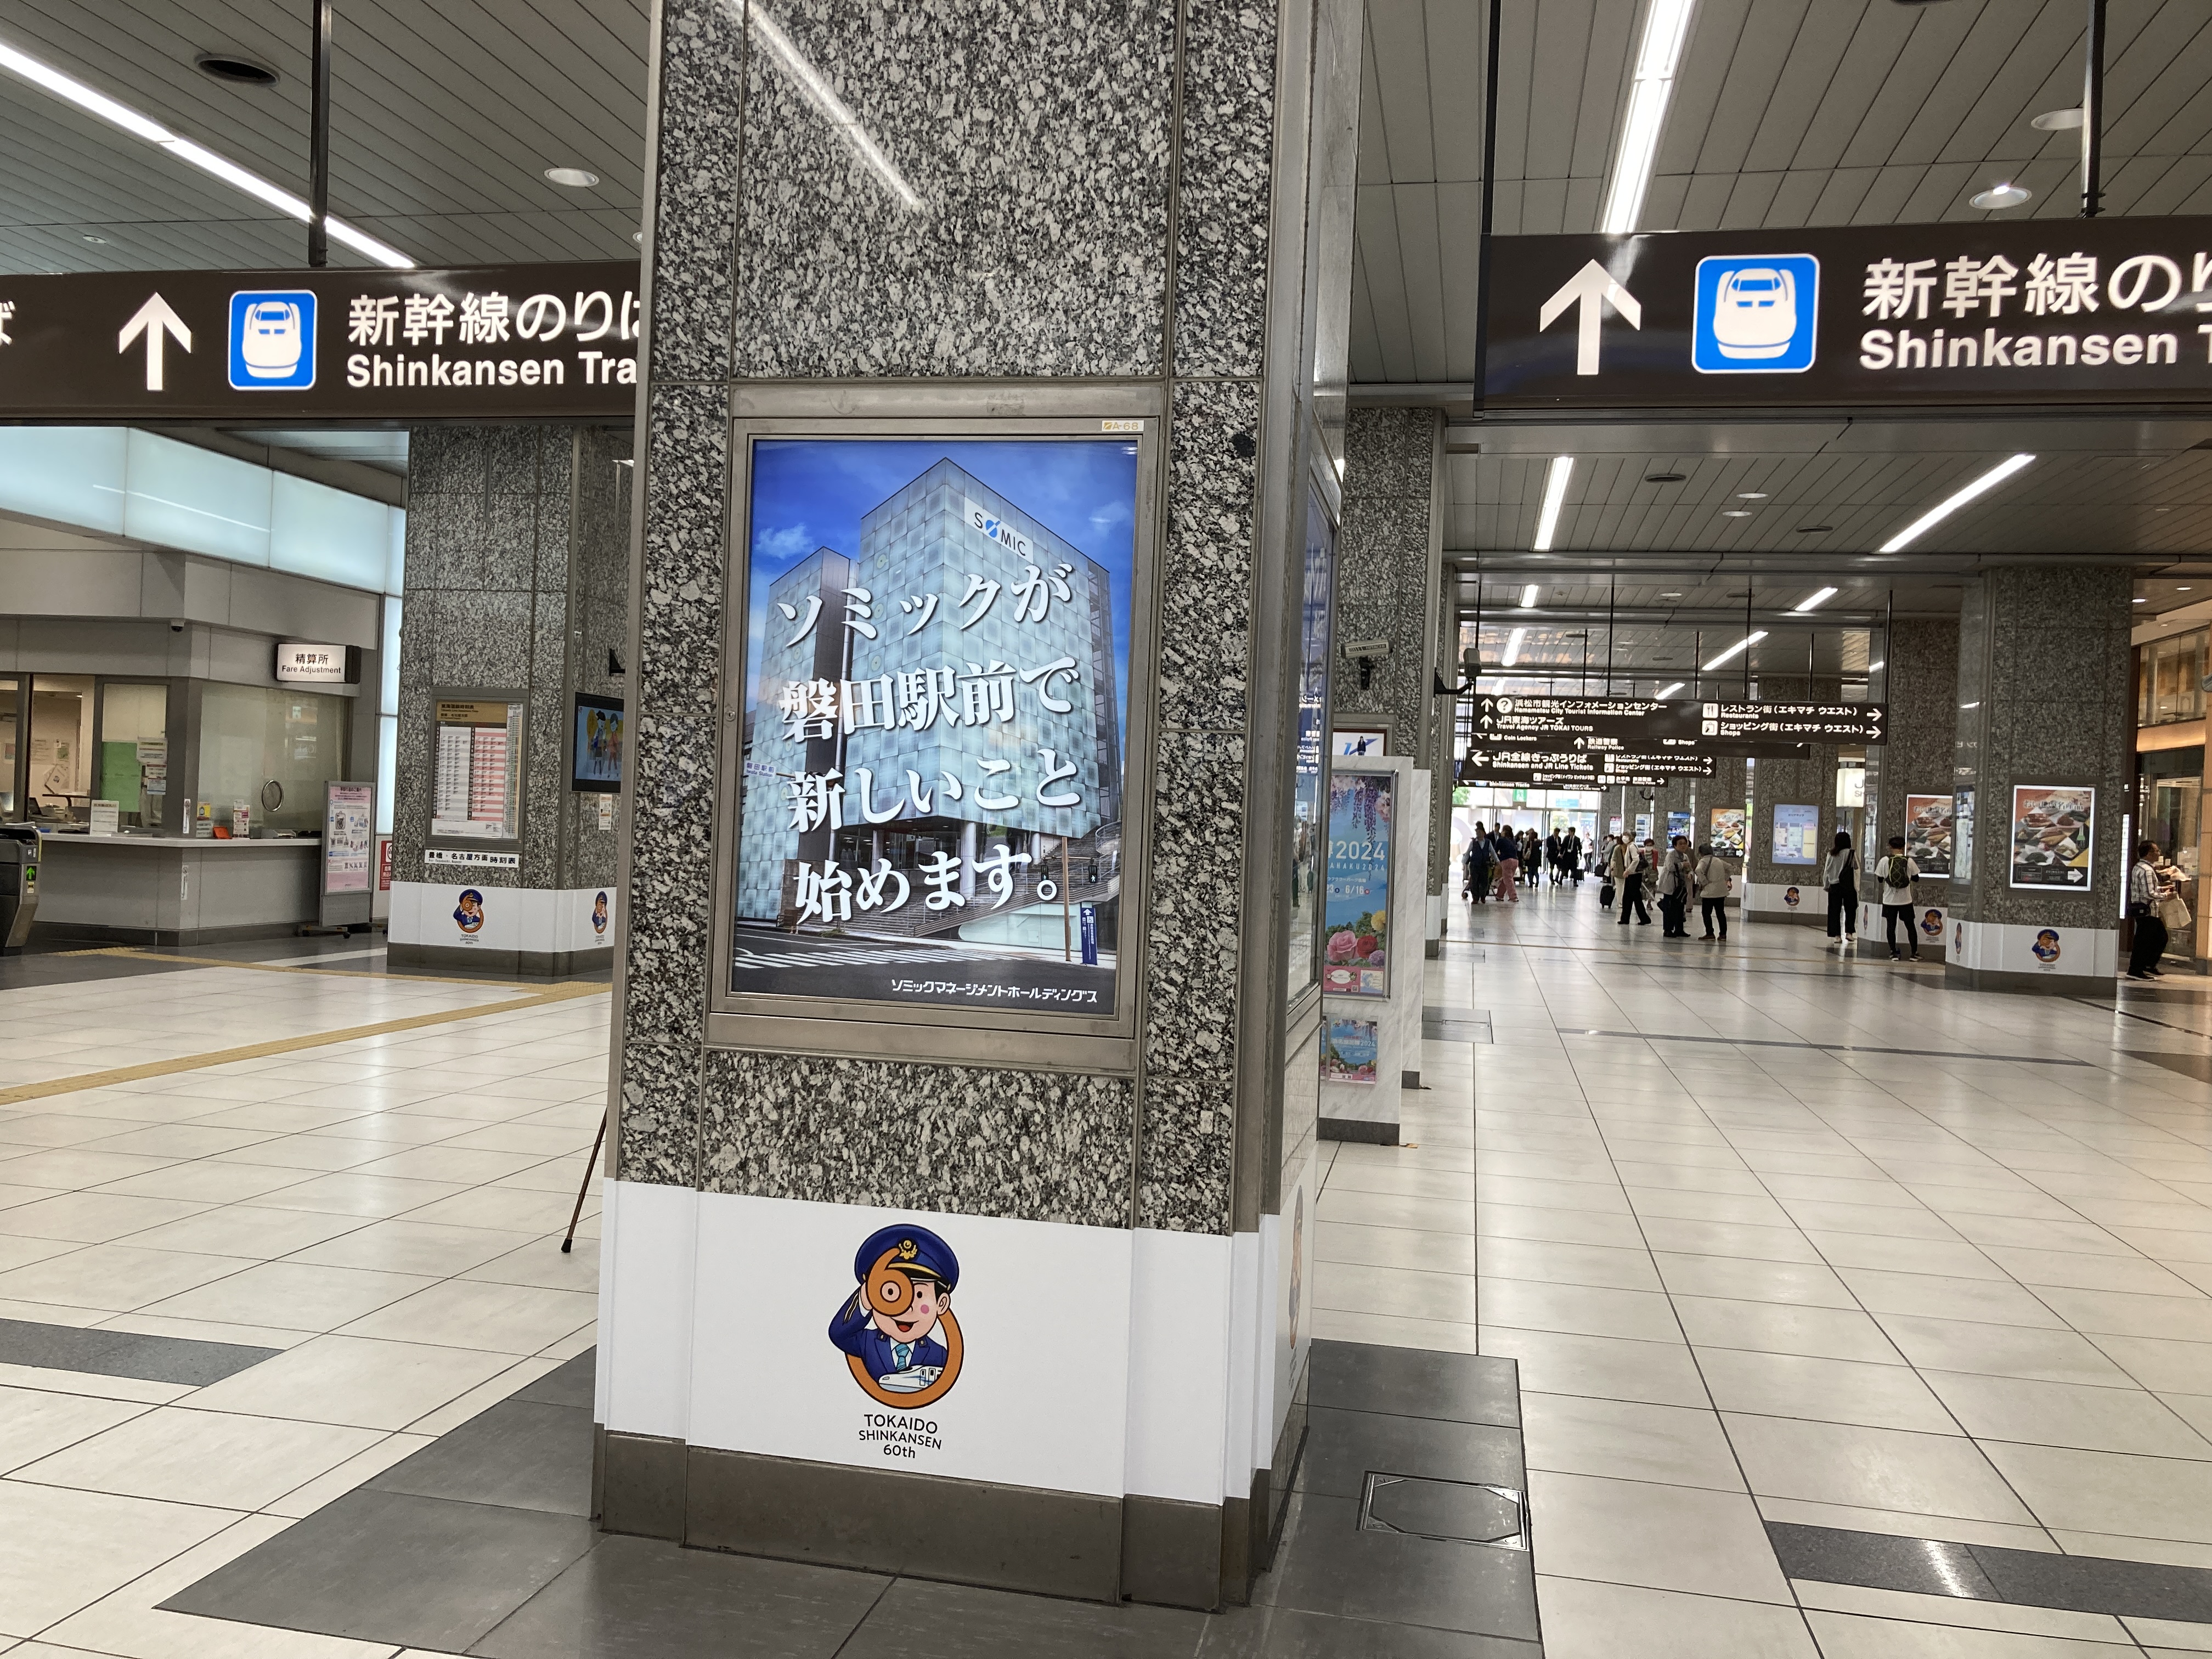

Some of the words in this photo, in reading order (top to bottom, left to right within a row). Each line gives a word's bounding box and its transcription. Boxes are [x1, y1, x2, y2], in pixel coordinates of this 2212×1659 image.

[1860, 328, 2177, 370] Shinkansen
[347, 353, 564, 387] Shinkansen
[1113, 422, 1138, 430] A-68
[777, 563, 1075, 647] ソミックが
[296, 653, 328, 664] 精算所
[300, 666, 341, 674] Adjustment
[780, 657, 1079, 742] 磐田駅前で
[1515, 699, 1667, 710] 浜松市観光インフォメーションセンター
[1497, 715, 1564, 725] JR東海ツアーズ
[787, 748, 1081, 833] 新しいこと
[793, 844, 1057, 924] 始めます。
[891, 979, 1097, 1003] ソミックマネージメントホールディングス
[864, 1414, 938, 1434] TOKAIDO
[859, 1430, 942, 1449] SHINKANSEN
[883, 1444, 916, 1458] 60th
